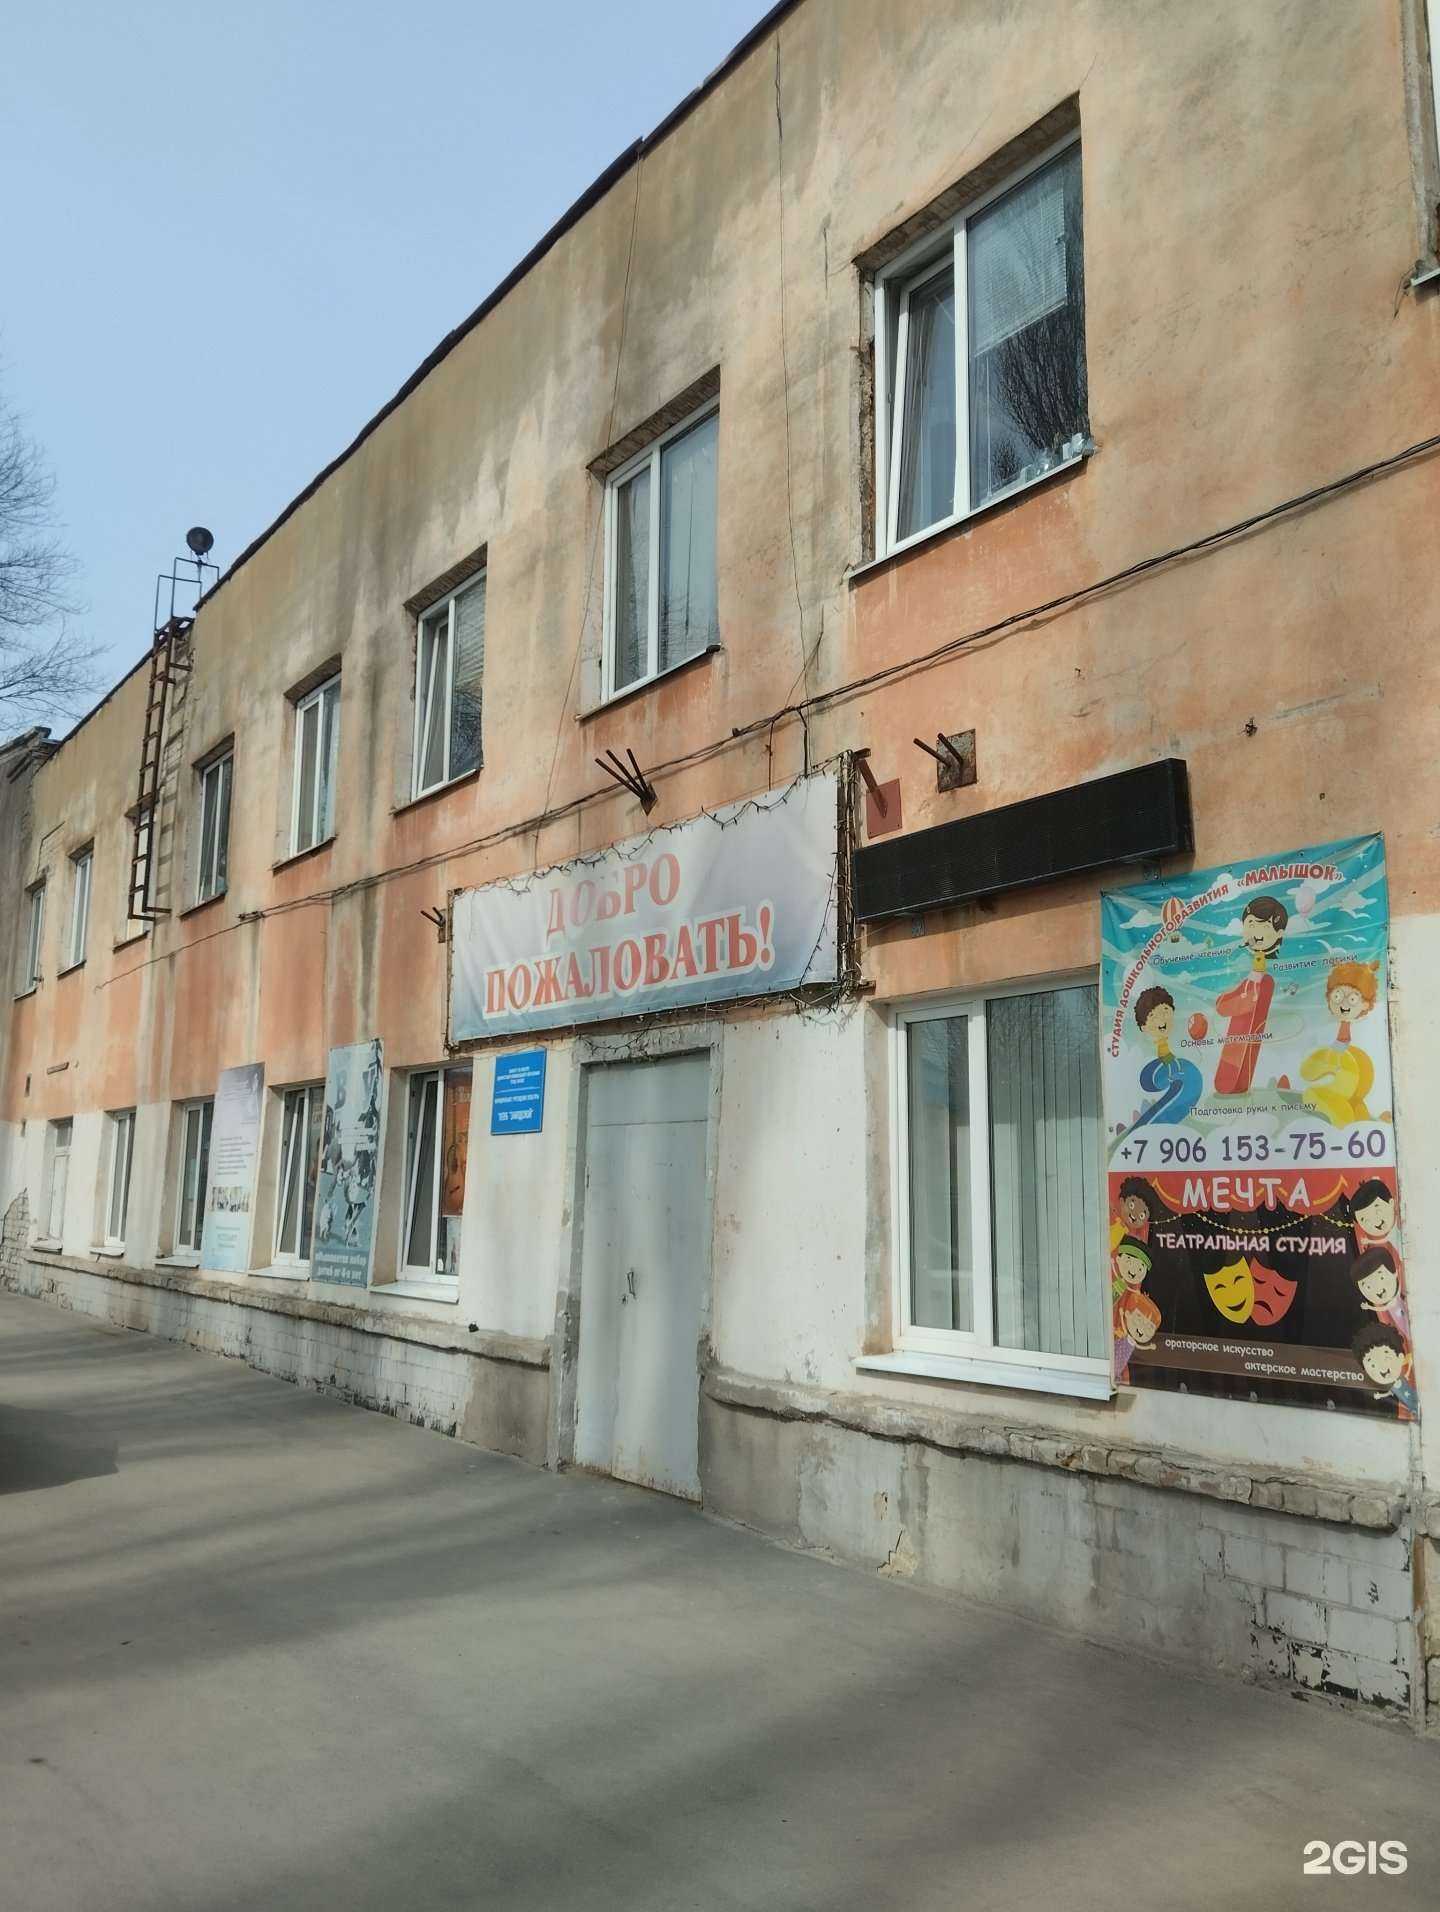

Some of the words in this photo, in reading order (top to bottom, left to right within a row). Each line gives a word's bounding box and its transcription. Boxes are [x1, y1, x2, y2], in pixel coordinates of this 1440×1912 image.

[485, 905, 772, 1014] ПОЖАЛОВАТЬ!
[1111, 1010, 1125, 1058] СТУДИЯ
[1119, 921, 1175, 1009] ДОШКОЛЬНОГО
[1174, 883, 1230, 925] РАЗВИТИЯ
[1273, 958, 1317, 972] Развитие
[1180, 1037, 1214, 1049] Основы
[1189, 1106, 1243, 1117] Подготовка
[1246, 1104, 1269, 1116] руки
[1281, 1100, 1318, 1113] письму
[1120, 1139, 1149, 1164] +7
[1160, 1136, 1208, 1164] 906
[1221, 1129, 1387, 1162] 153-75-60
[1182, 1176, 1311, 1209] МЕЧТА
[1156, 1232, 1270, 1253] ТЕАТРАЛЬНАЯ
[1275, 1235, 1348, 1255] СТУДИЯ
[1165, 1338, 1219, 1352] ораторское
[1223, 1343, 1274, 1357] искусство
[1244, 1360, 1297, 1375] актерское
[1301, 1367, 1365, 1382] мастерство
